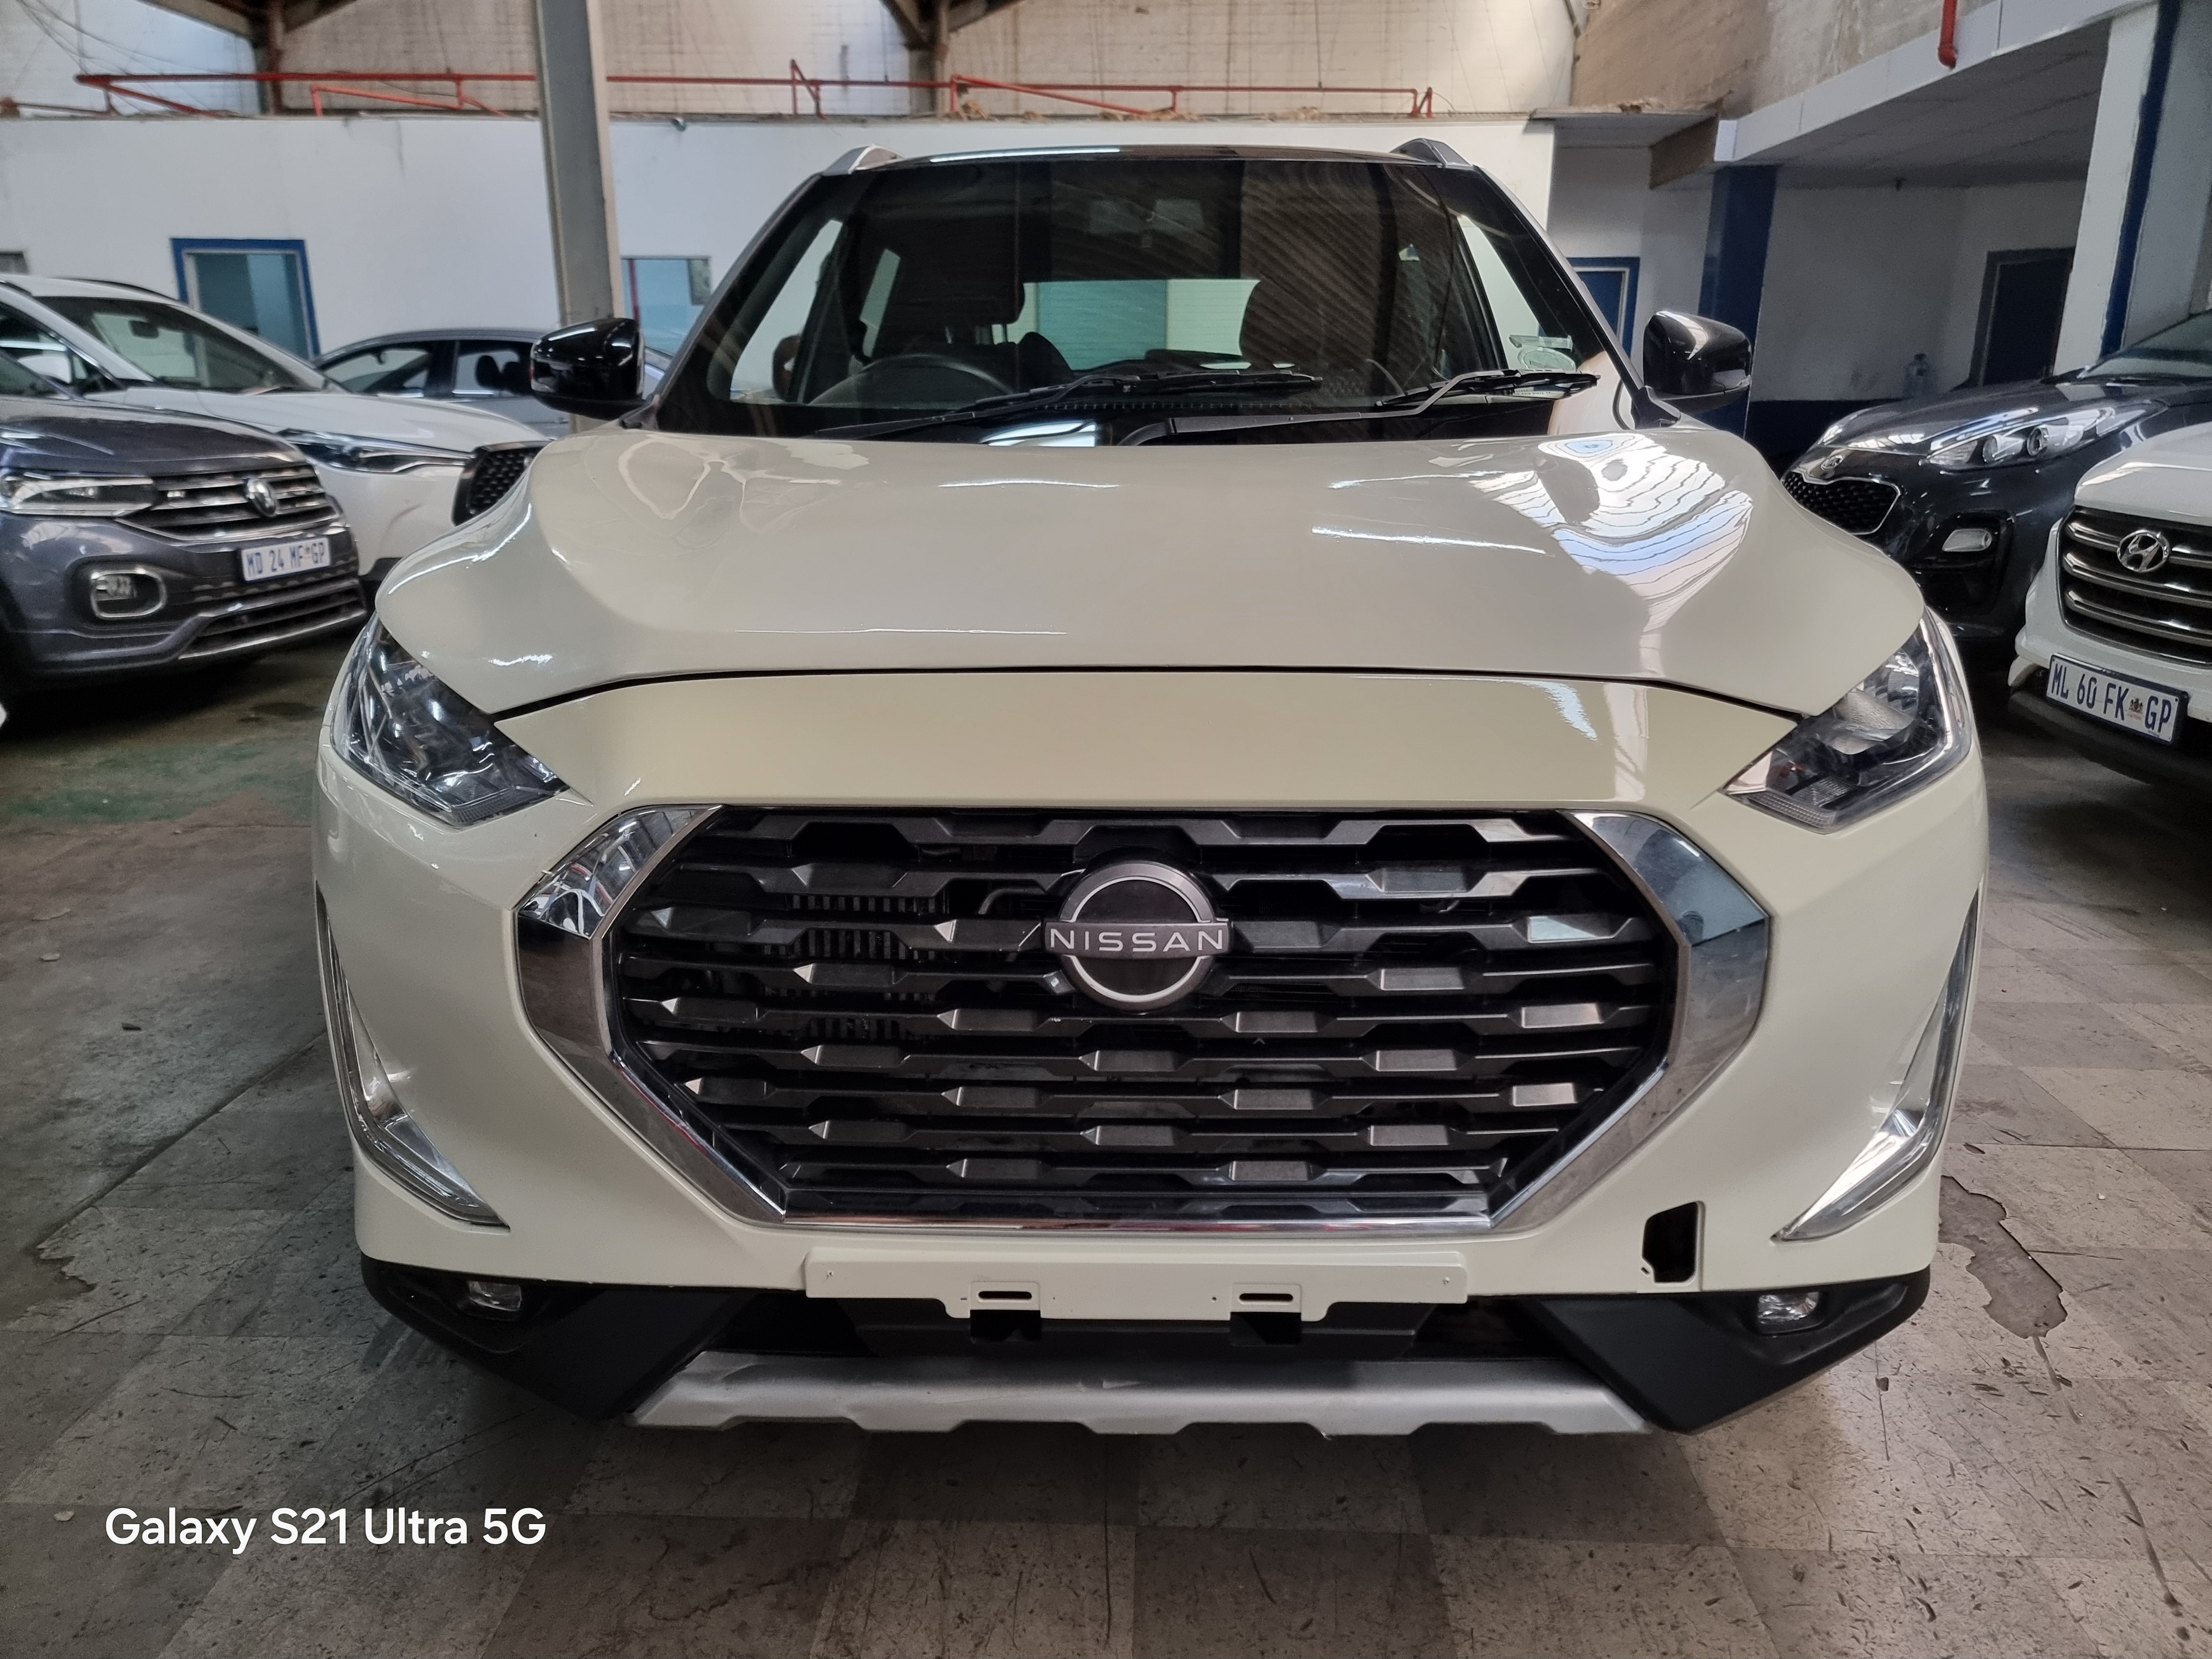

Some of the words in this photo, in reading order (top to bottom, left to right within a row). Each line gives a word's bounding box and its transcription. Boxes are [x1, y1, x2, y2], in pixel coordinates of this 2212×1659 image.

[246, 552, 263, 576] MD
[269, 549, 284, 572] 24
[311, 541, 325, 564] GP
[2051, 663, 2069, 699] ML
[2077, 674, 2097, 709] 60
[2103, 682, 2129, 721] FK
[2145, 695, 2172, 733] GP
[1050, 928, 1223, 952] NISSAN
